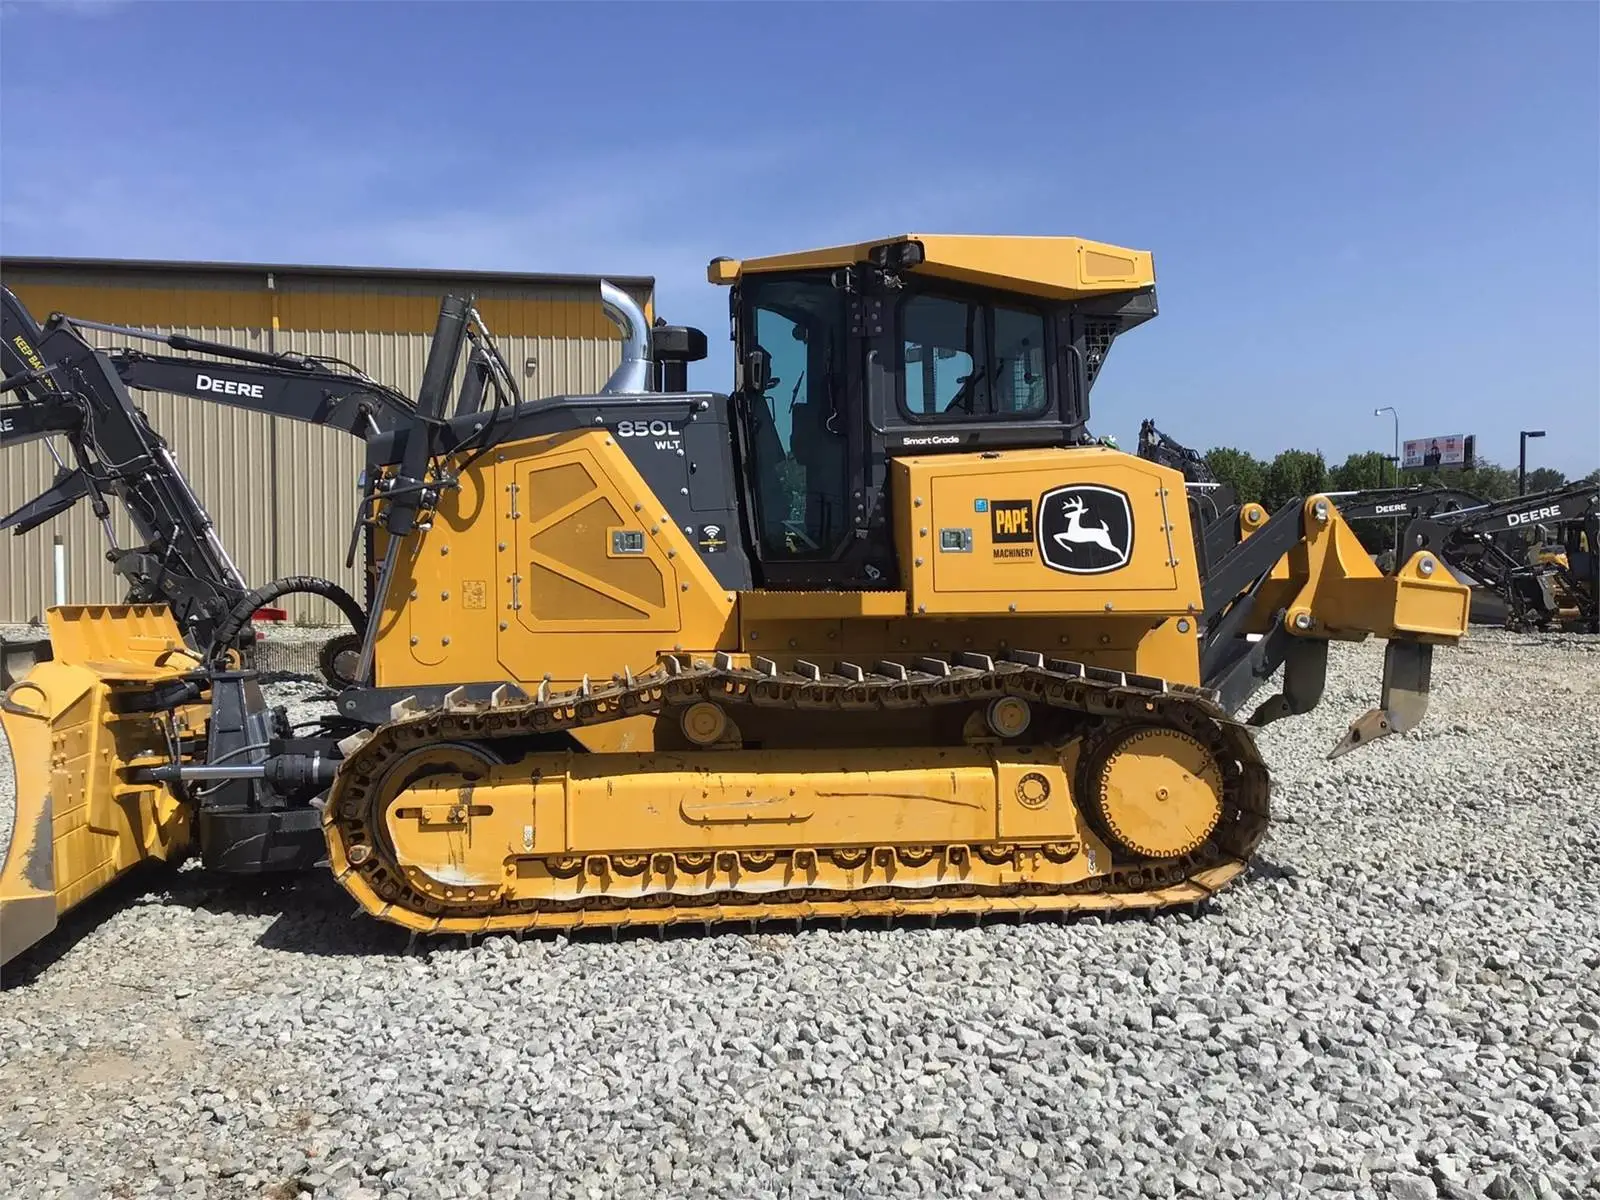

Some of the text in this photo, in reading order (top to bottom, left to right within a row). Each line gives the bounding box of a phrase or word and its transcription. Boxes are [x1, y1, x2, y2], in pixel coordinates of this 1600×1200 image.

[13, 335, 33, 356] KEEP
[196, 374, 264, 399] DEERE
[617, 420, 680, 437] 850L
[654, 440, 680, 450] WLT
[903, 435, 960, 446] Smart Grade
[1375, 503, 1407, 514] DEERE
[1507, 505, 1562, 527] DEERE
[993, 548, 1033, 558] MACHINERY
